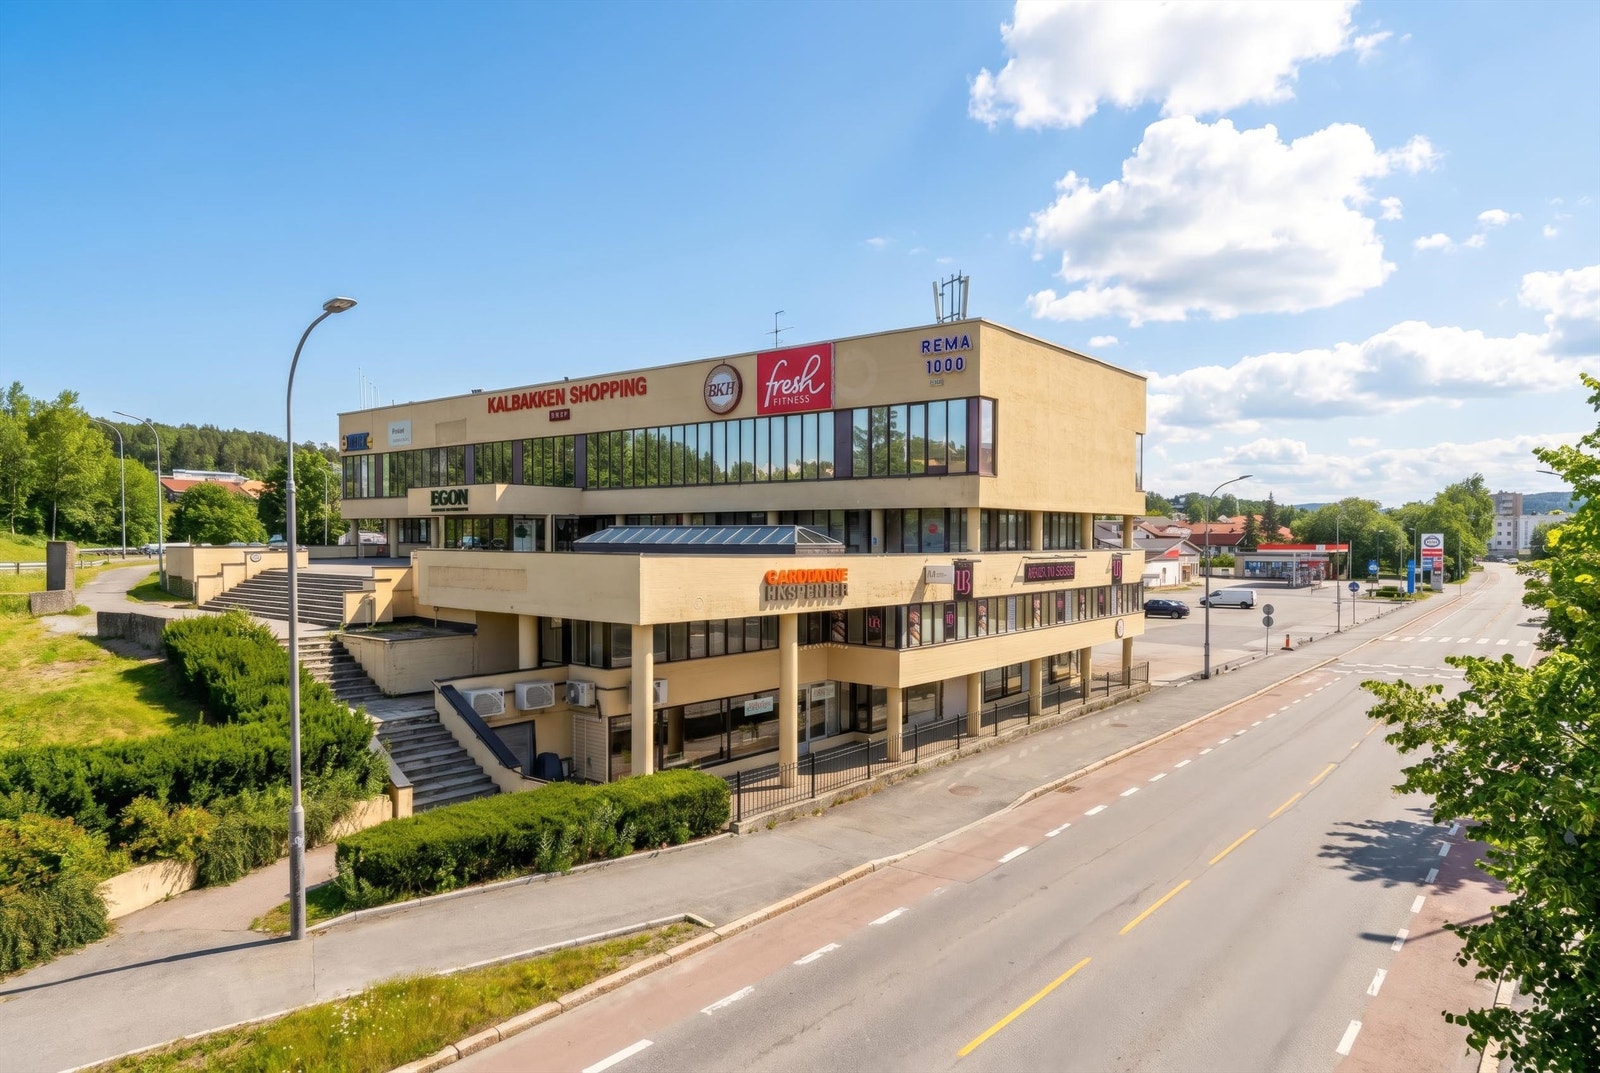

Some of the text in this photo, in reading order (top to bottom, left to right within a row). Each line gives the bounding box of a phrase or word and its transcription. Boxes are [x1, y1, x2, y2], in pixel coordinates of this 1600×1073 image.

[921, 334, 970, 354] REMA
[926, 357, 963, 374] 1000
[708, 381, 736, 398] BKH
[764, 354, 825, 408] fresh
[487, 376, 648, 414] KALBAKKEN SHOPPING
[773, 394, 810, 406] FITNESS
[430, 488, 469, 506] EGON
